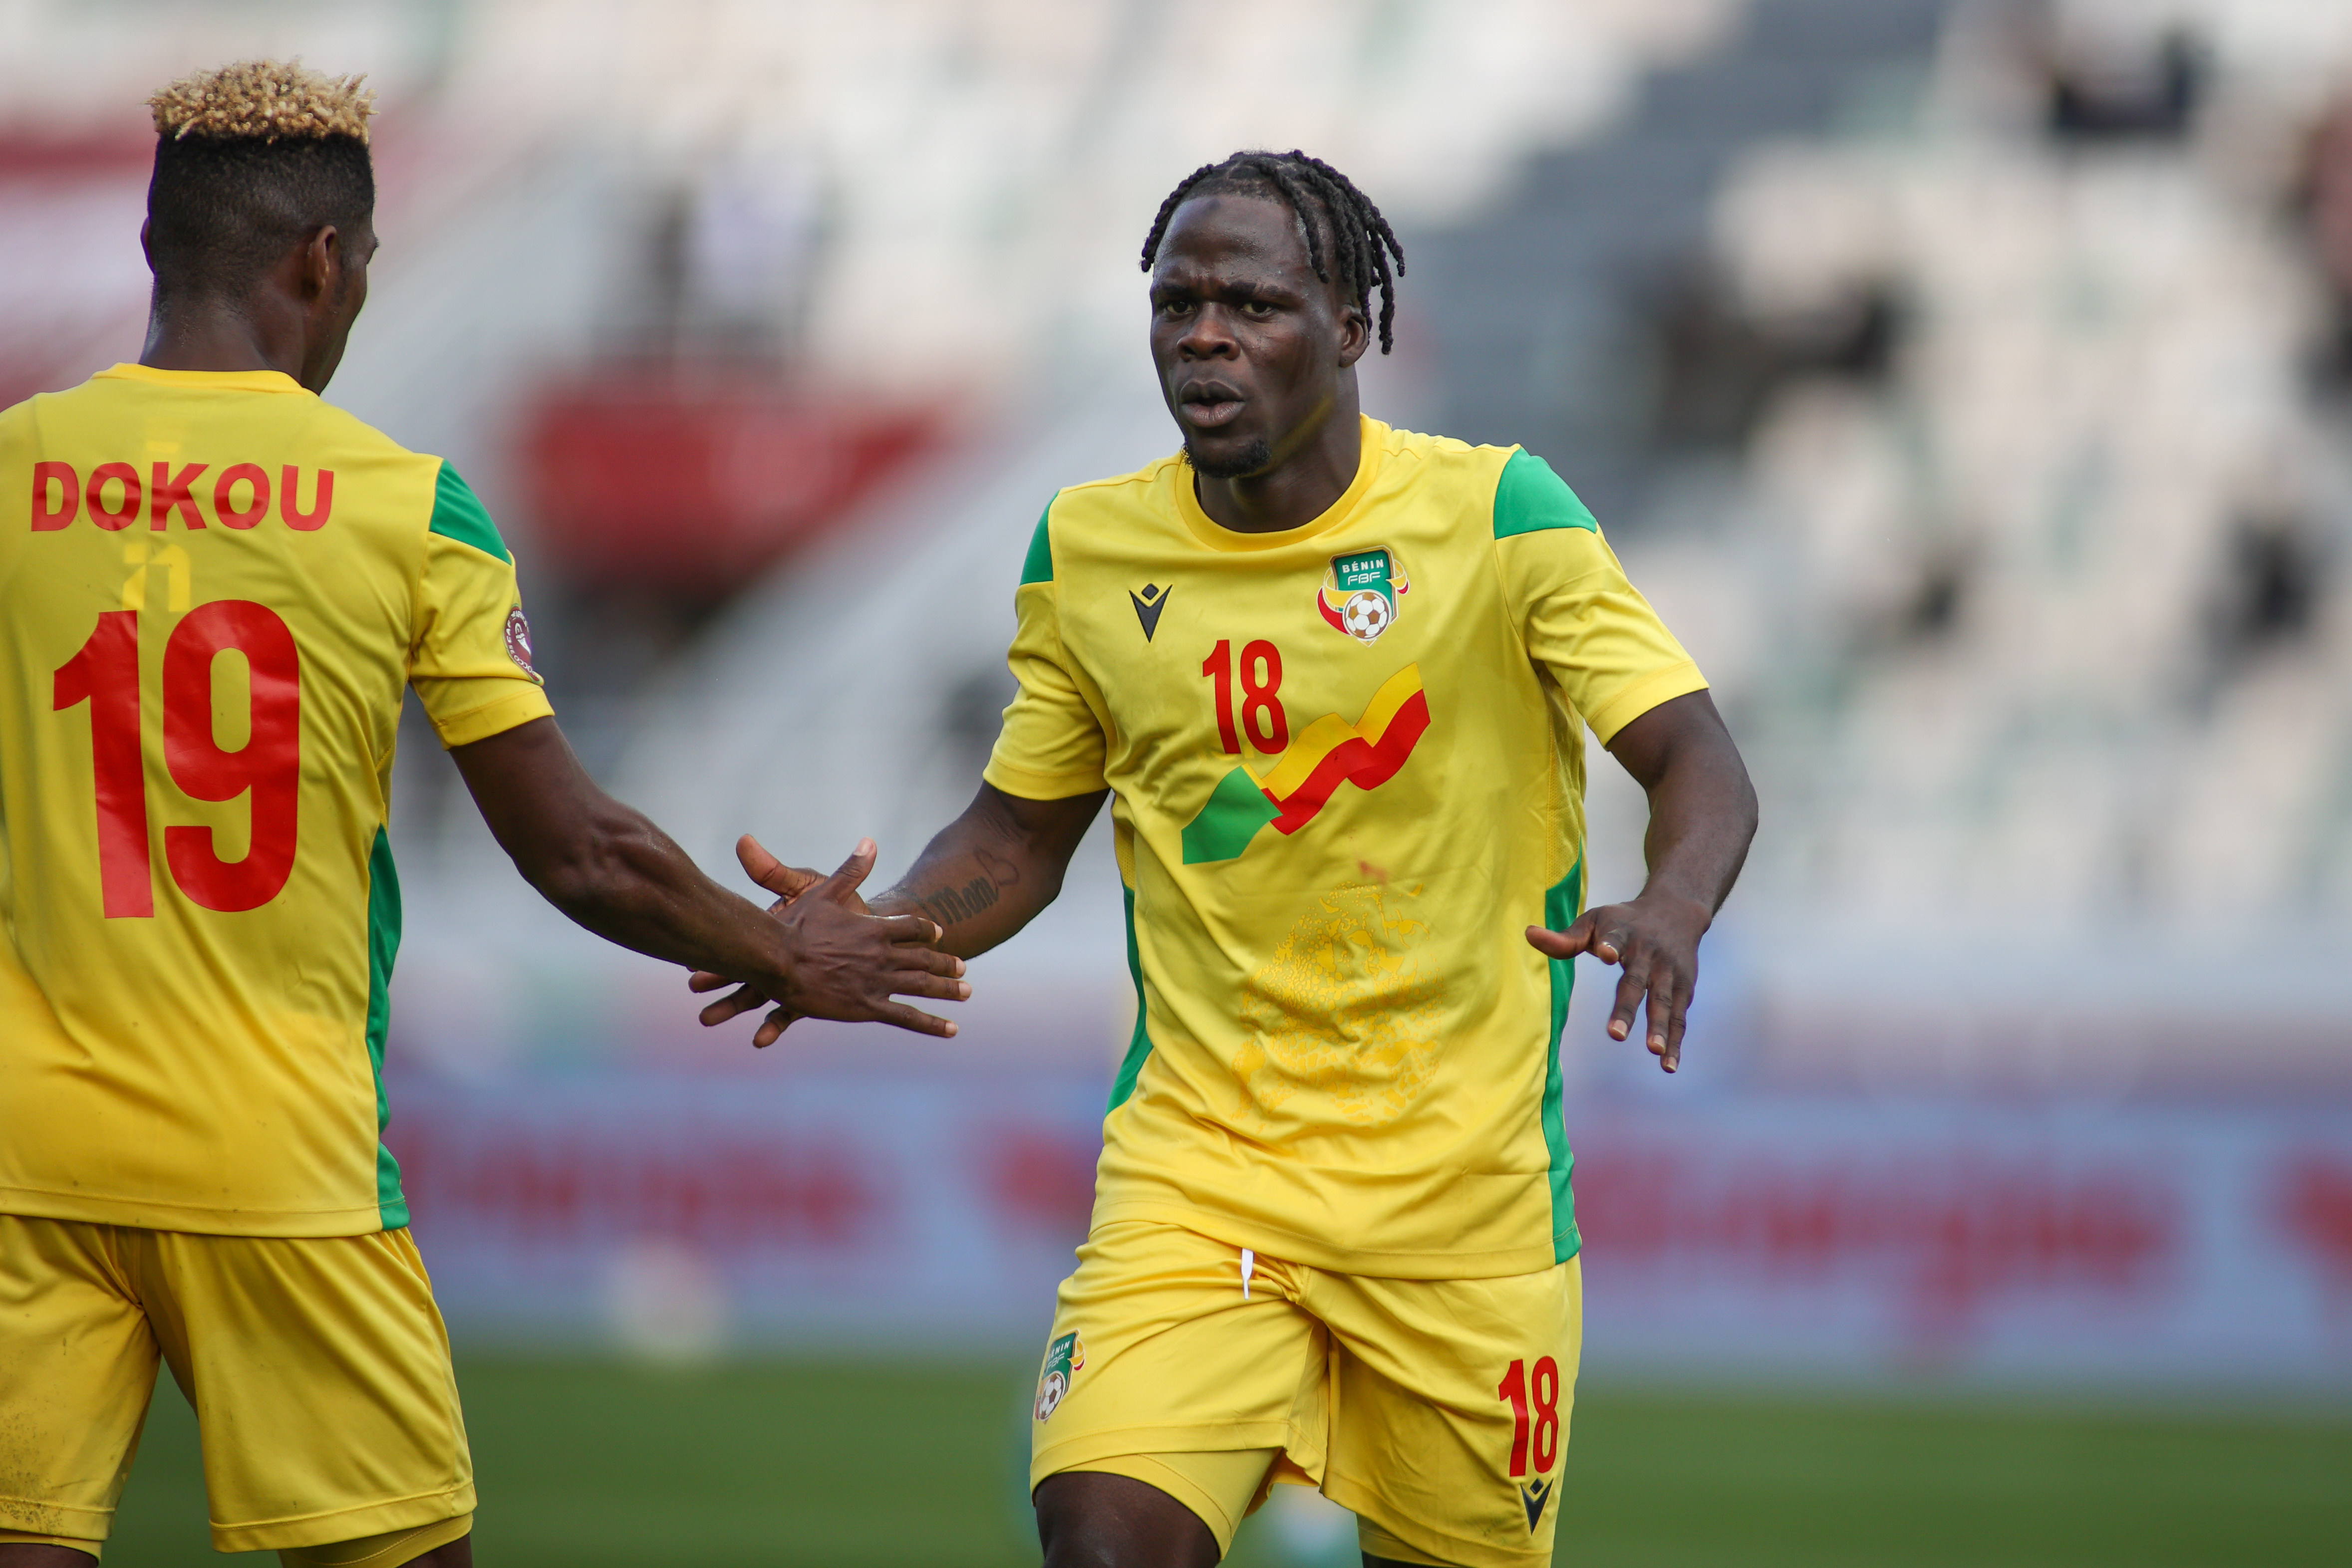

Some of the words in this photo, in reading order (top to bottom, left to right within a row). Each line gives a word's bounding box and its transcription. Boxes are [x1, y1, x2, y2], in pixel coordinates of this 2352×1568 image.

[32, 462, 333, 531] DOKOU
[1342, 558, 1384, 573] BÉNIN
[1348, 571, 1380, 586] FBF
[1202, 639, 1289, 755] 18
[53, 599, 299, 919] 19
[1498, 1355, 1558, 1477] 18
